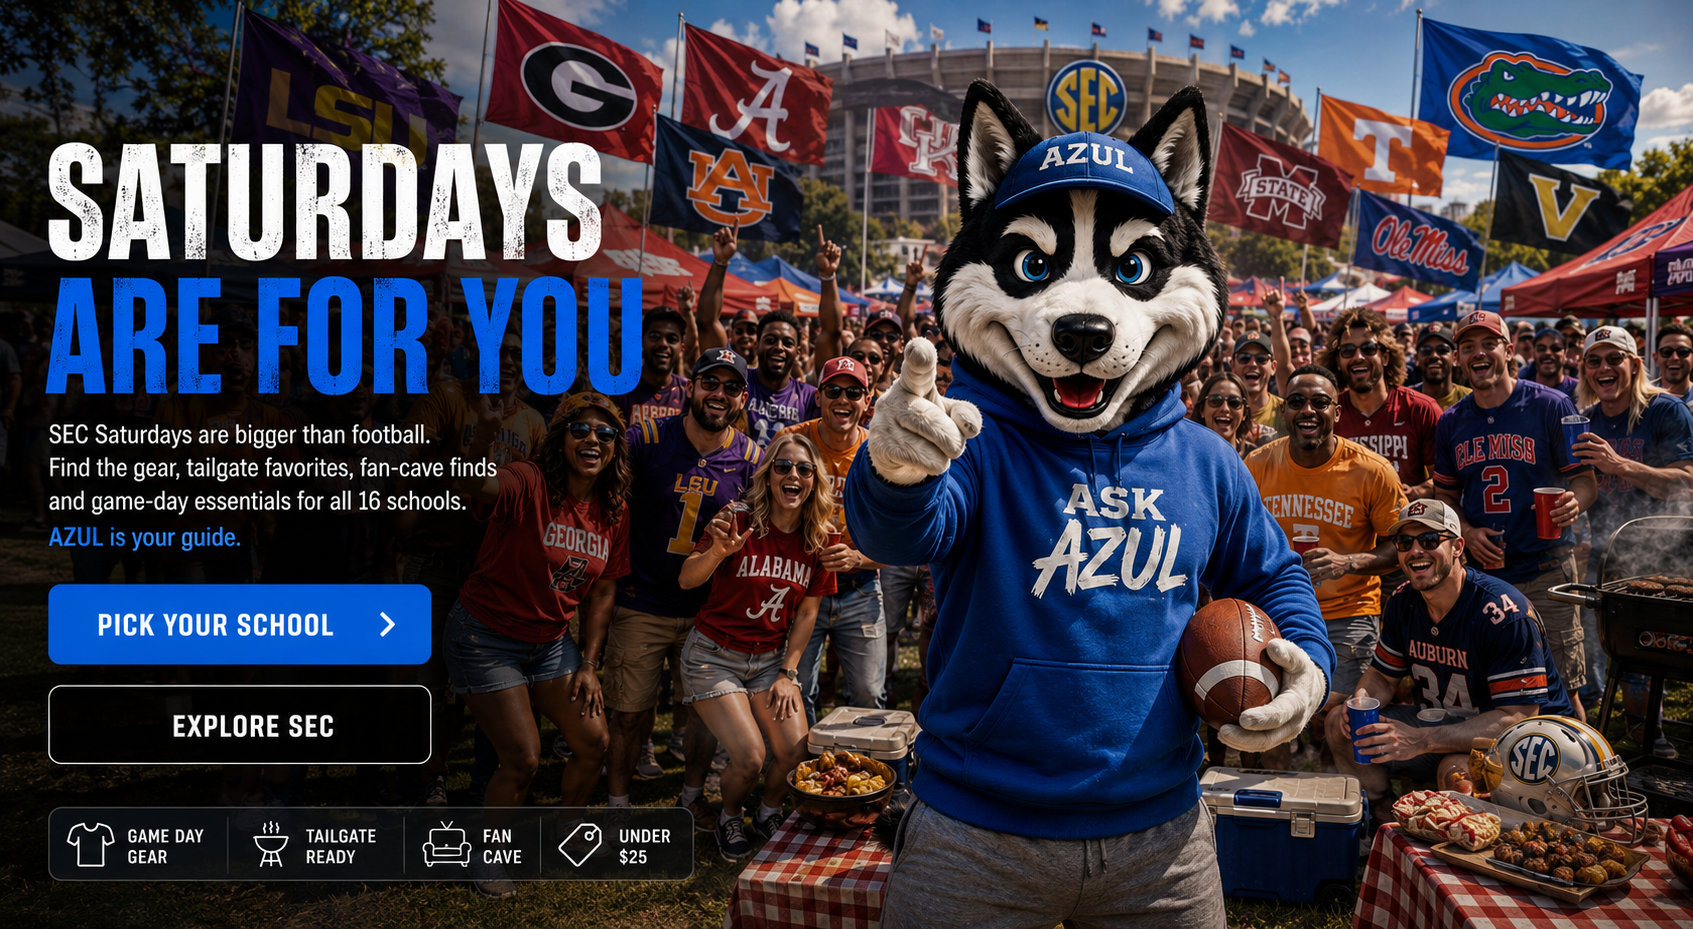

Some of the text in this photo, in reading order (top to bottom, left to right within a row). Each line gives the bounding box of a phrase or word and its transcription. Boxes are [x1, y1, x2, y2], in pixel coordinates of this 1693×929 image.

[521, 42, 637, 131] G
[709, 60, 793, 152] A
[1055, 67, 1119, 132] SEC
[266, 67, 428, 167] LSU
[1039, 142, 1134, 174] AZUL
[1353, 118, 1412, 183] T
[1256, 179, 1309, 207] STATE
[1528, 173, 1601, 242] V
[1372, 215, 1469, 276] Ole Miss
[674, 473, 719, 497] LSU
[1063, 483, 1166, 522] ASK
[1481, 465, 1511, 514] 2
[666, 490, 703, 556] 1
[1263, 494, 1354, 529] TENNESSEE
[543, 521, 610, 563] GEORGIA
[1031, 517, 1188, 598] AZUL
[736, 555, 812, 589] ALABAMA
[745, 583, 791, 622] A
[1482, 594, 1520, 625] 34
[1409, 639, 1470, 670] AUBURN
[1411, 663, 1480, 719] 34
[1511, 736, 1556, 780] SEC
